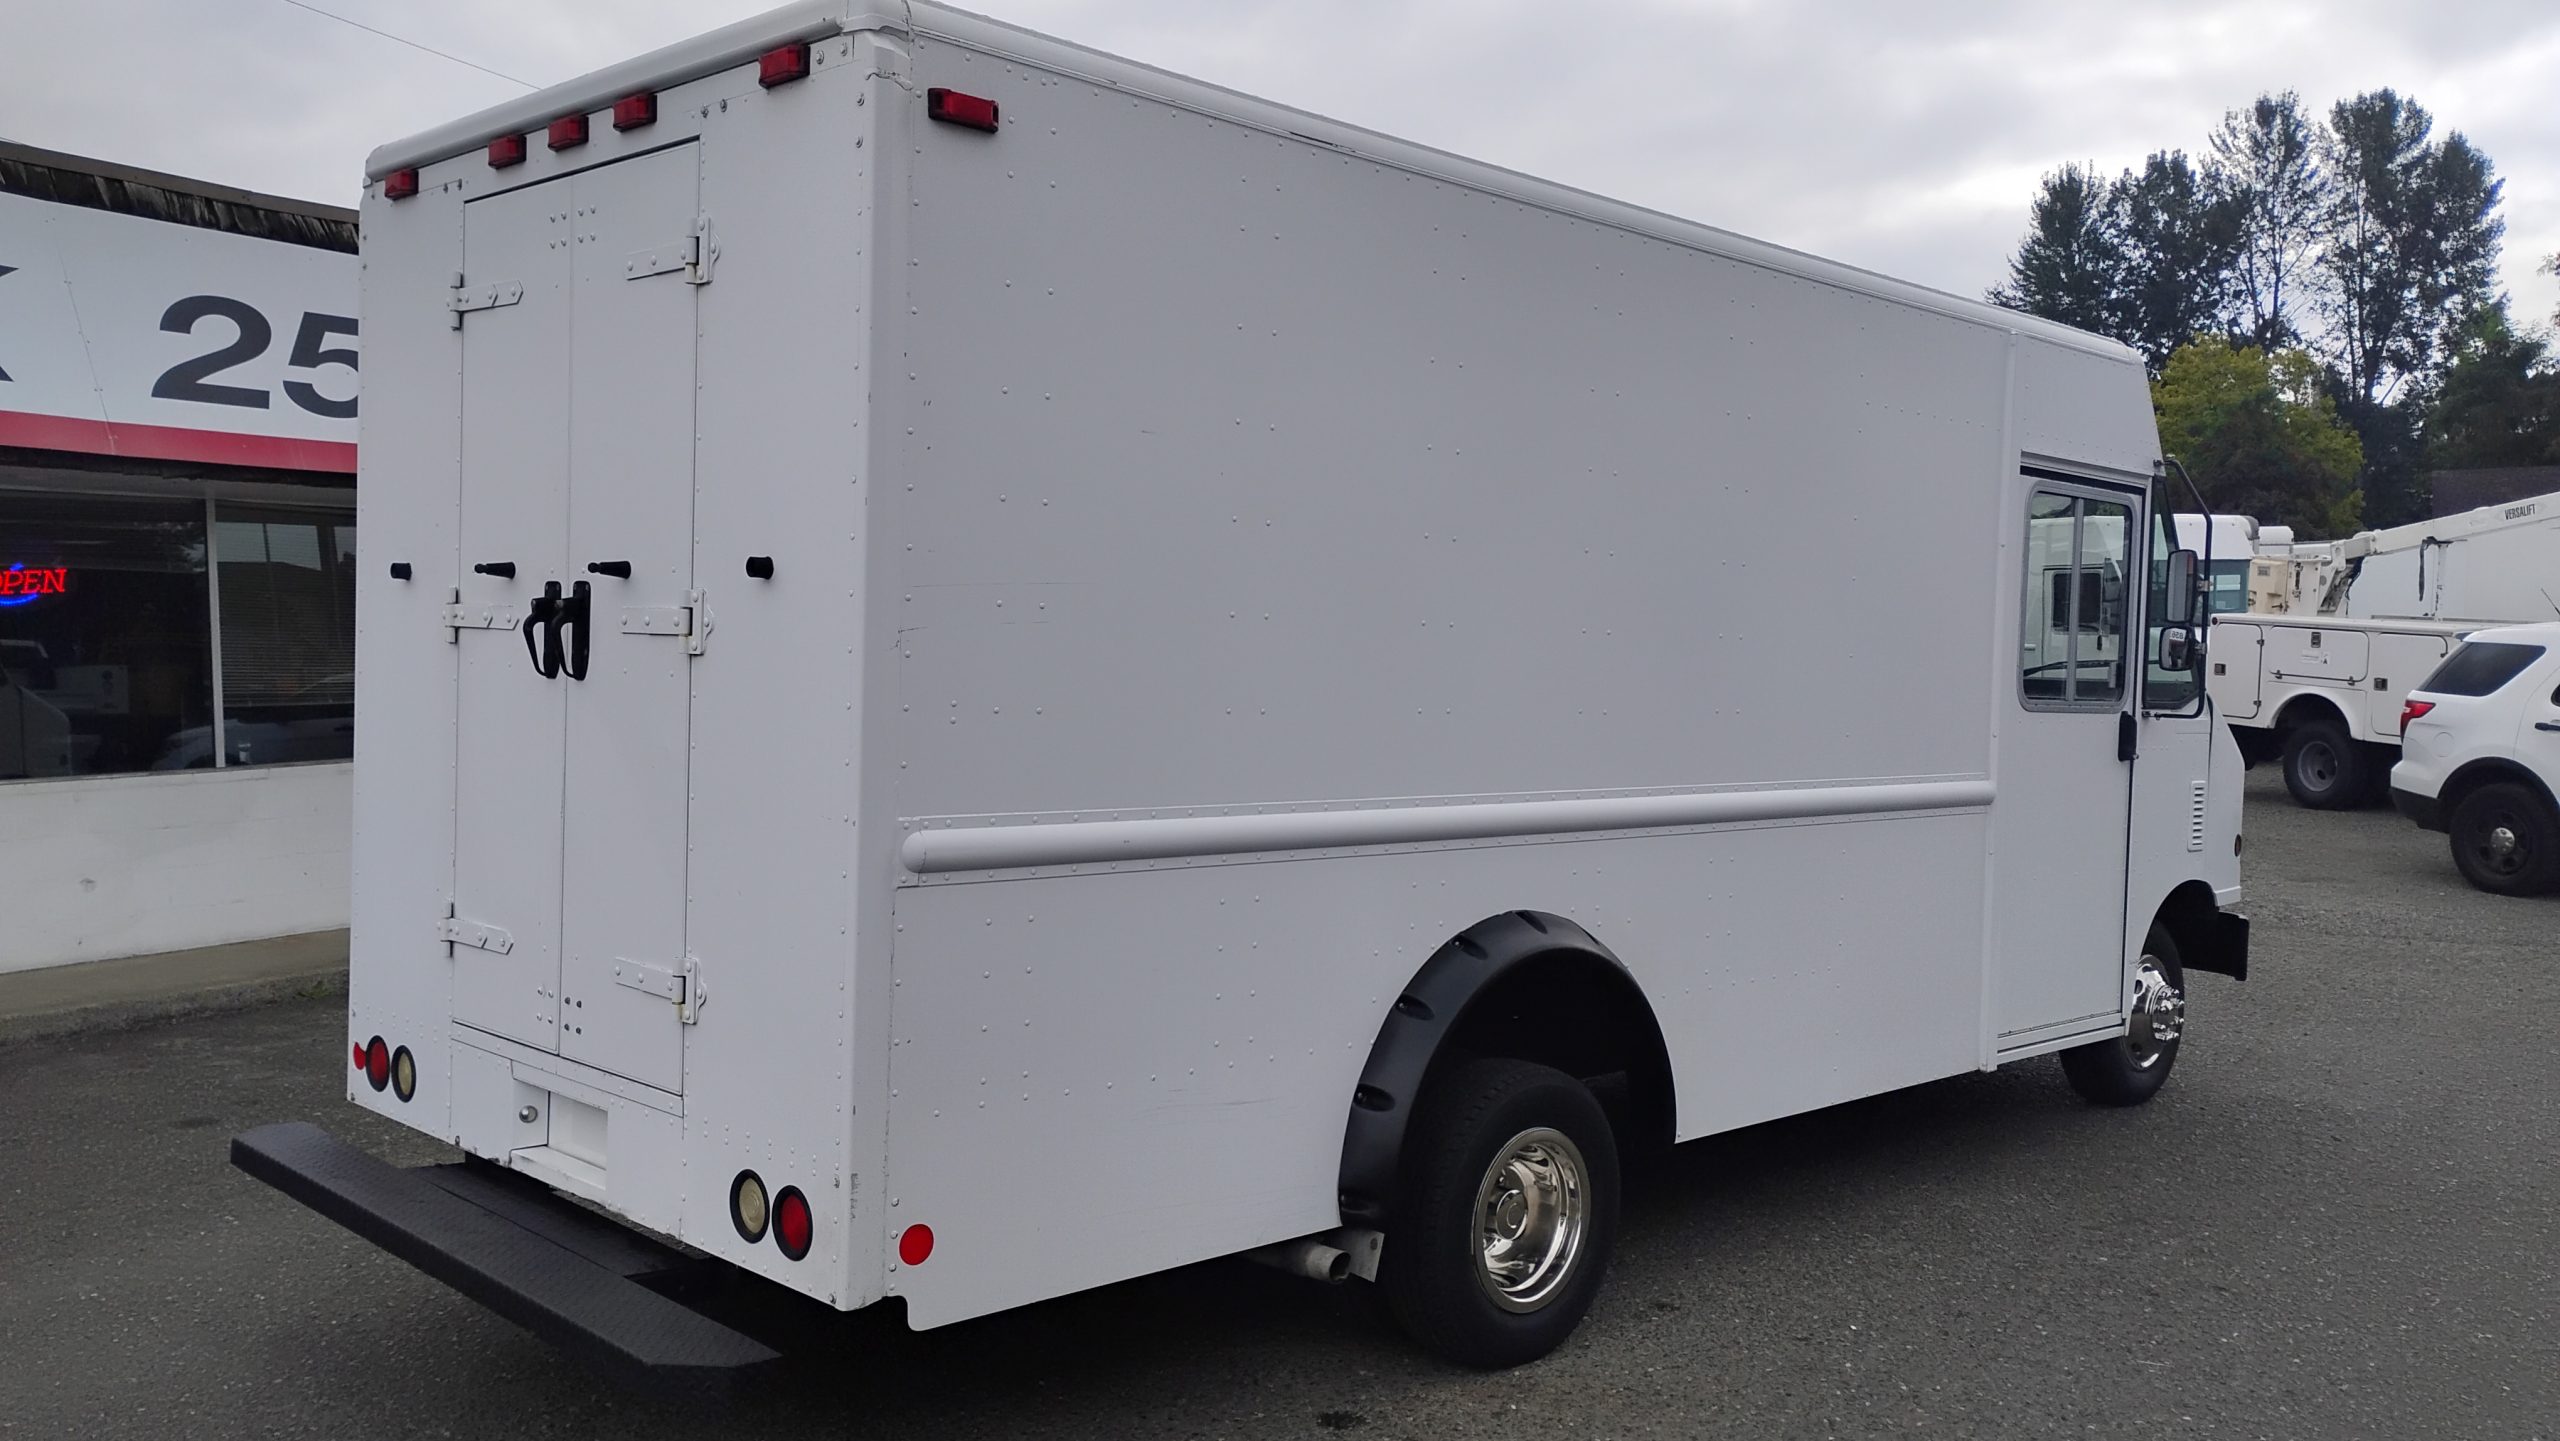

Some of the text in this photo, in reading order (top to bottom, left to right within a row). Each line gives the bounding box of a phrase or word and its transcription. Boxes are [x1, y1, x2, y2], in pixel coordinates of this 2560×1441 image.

[151, 295, 358, 418] 25
[2504, 503, 2536, 520] VERSALIFT
[0, 567, 67, 595] PEN
